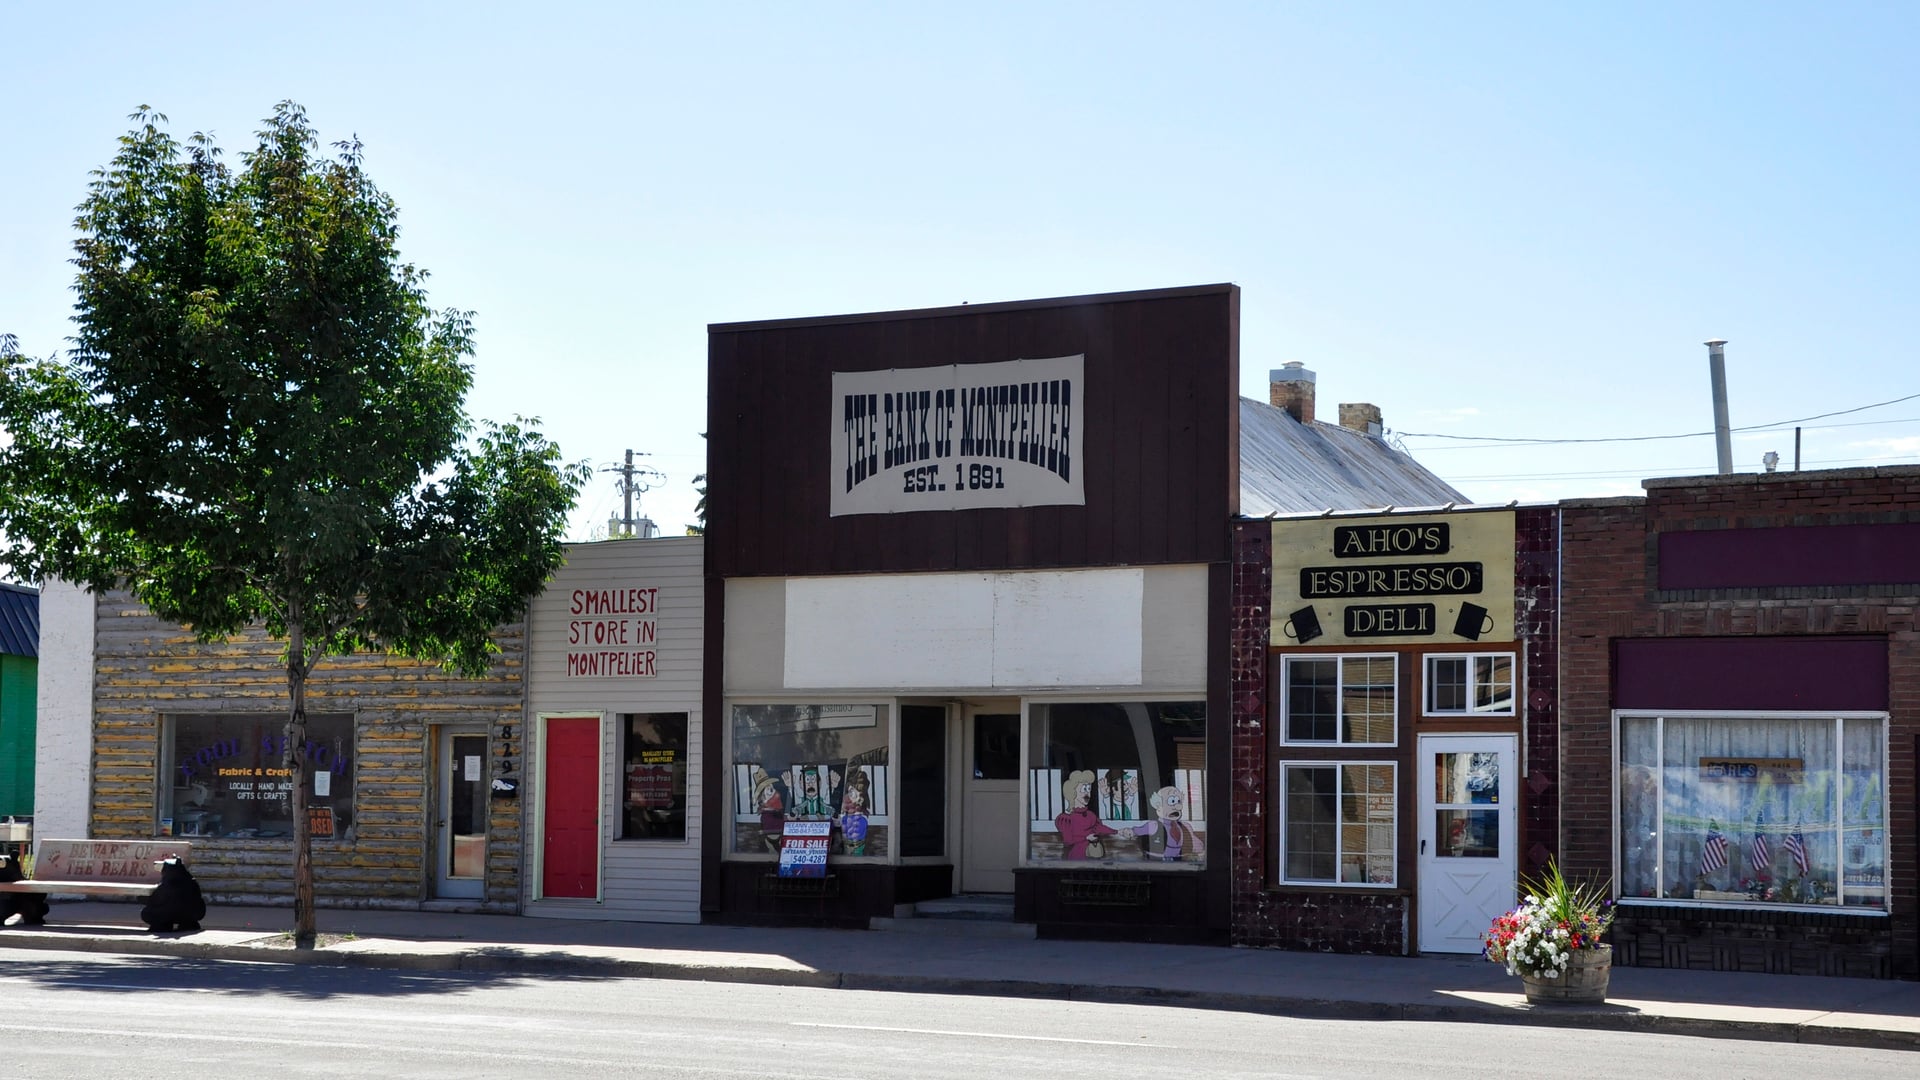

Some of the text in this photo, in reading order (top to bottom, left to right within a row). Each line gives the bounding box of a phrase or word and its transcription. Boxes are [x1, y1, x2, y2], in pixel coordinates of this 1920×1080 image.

[844, 379, 1071, 495] THE BANK OF MONTPELIER
[903, 463, 1005, 493] EST. 1891
[1343, 527, 1441, 554] AHO'S
[1310, 566, 1471, 594] ESPRESSO
[570, 588, 658, 614] SMALLEST
[1352, 607, 1428, 632] DELI
[569, 620, 629, 645] STORE
[181, 738, 240, 777] COOL
[218, 767, 252, 777] Fabric
[255, 767, 263, 777] &
[229, 782, 254, 791] LOCALLY
[258, 782, 275, 791] HAND
[237, 792, 255, 800] GIFTS
[263, 792, 288, 800] CRAFTS
[69, 843, 153, 860] BEWARE OF
[785, 839, 829, 848] FOR SALE
[66, 859, 149, 876] THE BEARS
[793, 855, 826, 864] 540-4287
